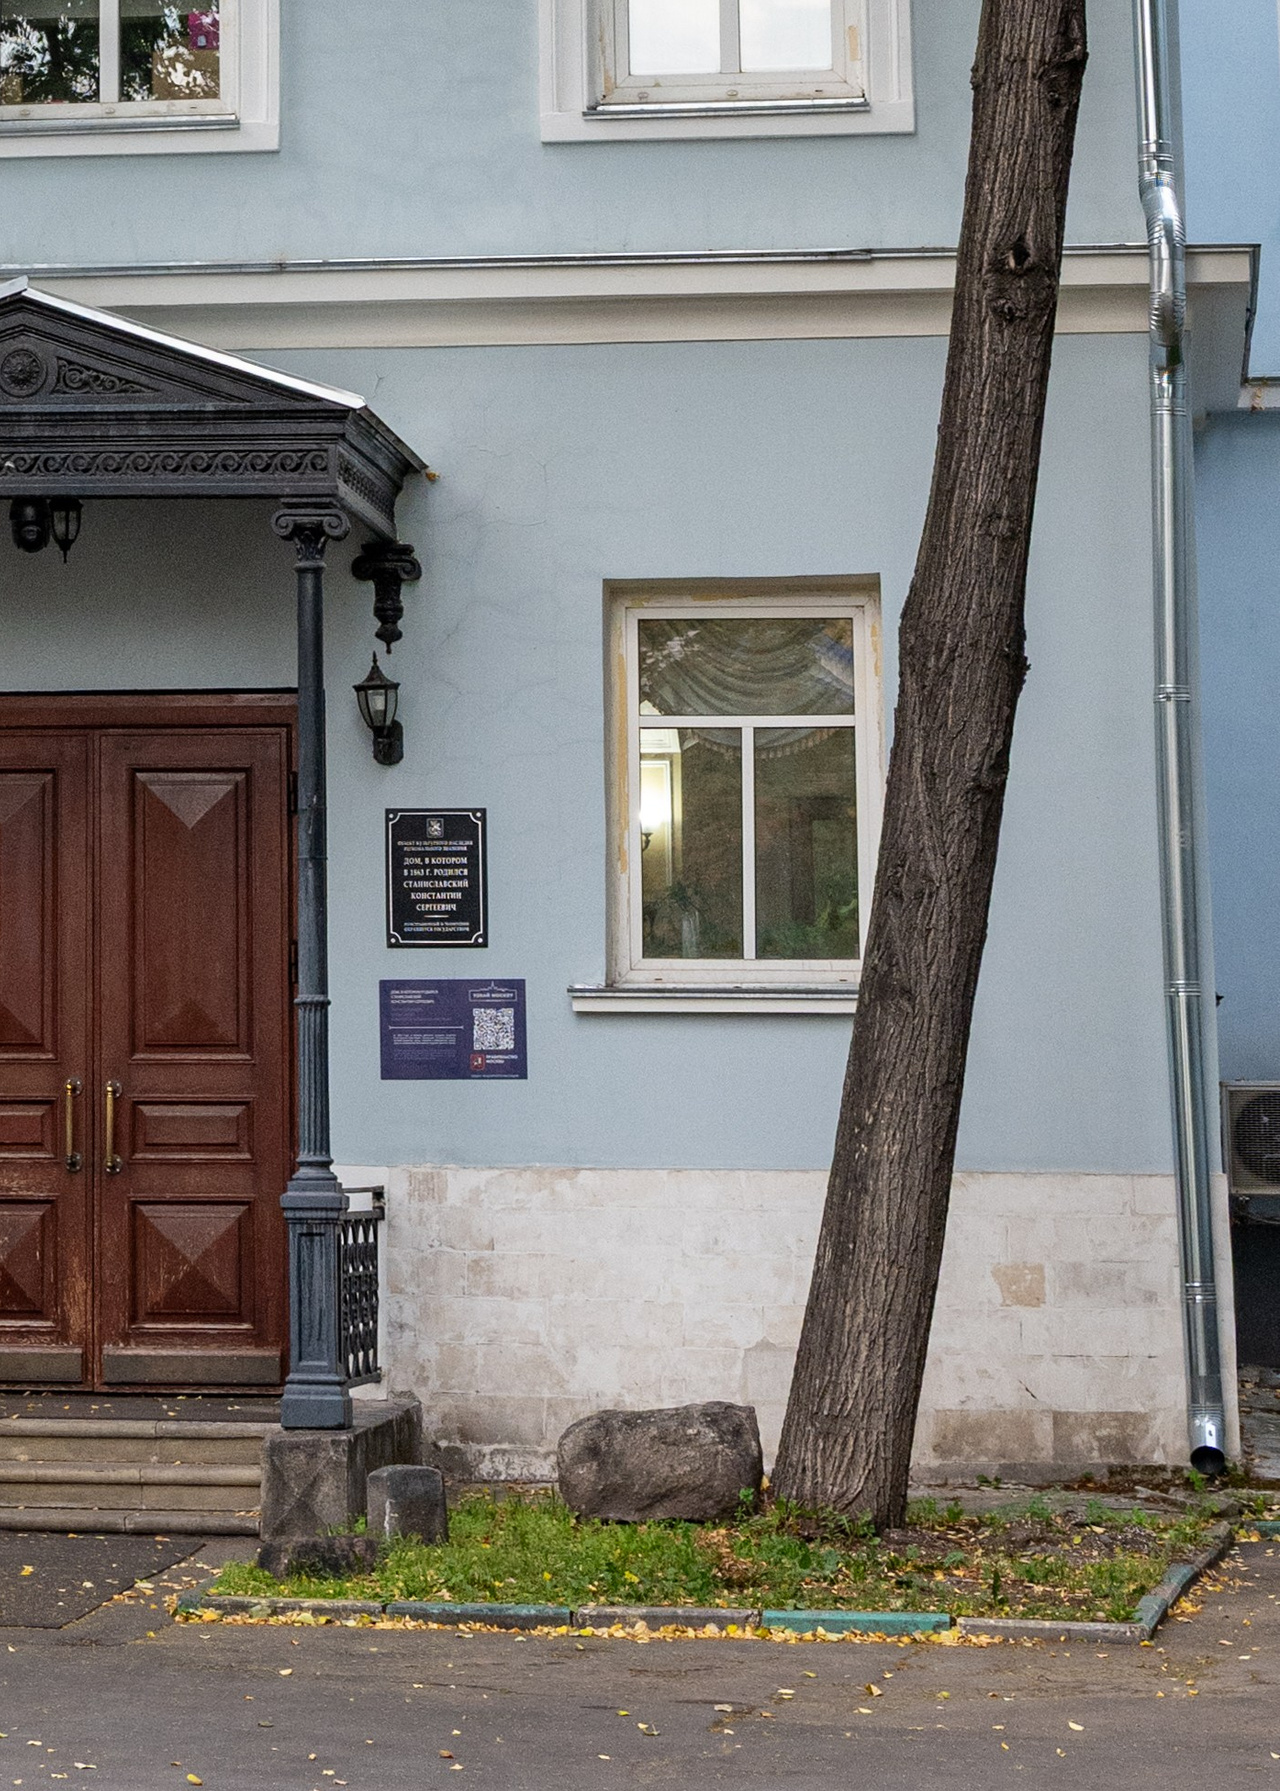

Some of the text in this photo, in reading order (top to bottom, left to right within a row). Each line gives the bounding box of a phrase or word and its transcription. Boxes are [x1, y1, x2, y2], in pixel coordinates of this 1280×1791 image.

[403, 857, 468, 865] ДОМ, В КОТОРОМ
[434, 868, 468, 876] РОДИЛСЯ
[403, 879, 469, 888] СТАНИСЛАВСКИЙ
[410, 892, 462, 900] КОНСТАНТИН
[416, 903, 457, 911] СЕРГЕЕВИЧ
